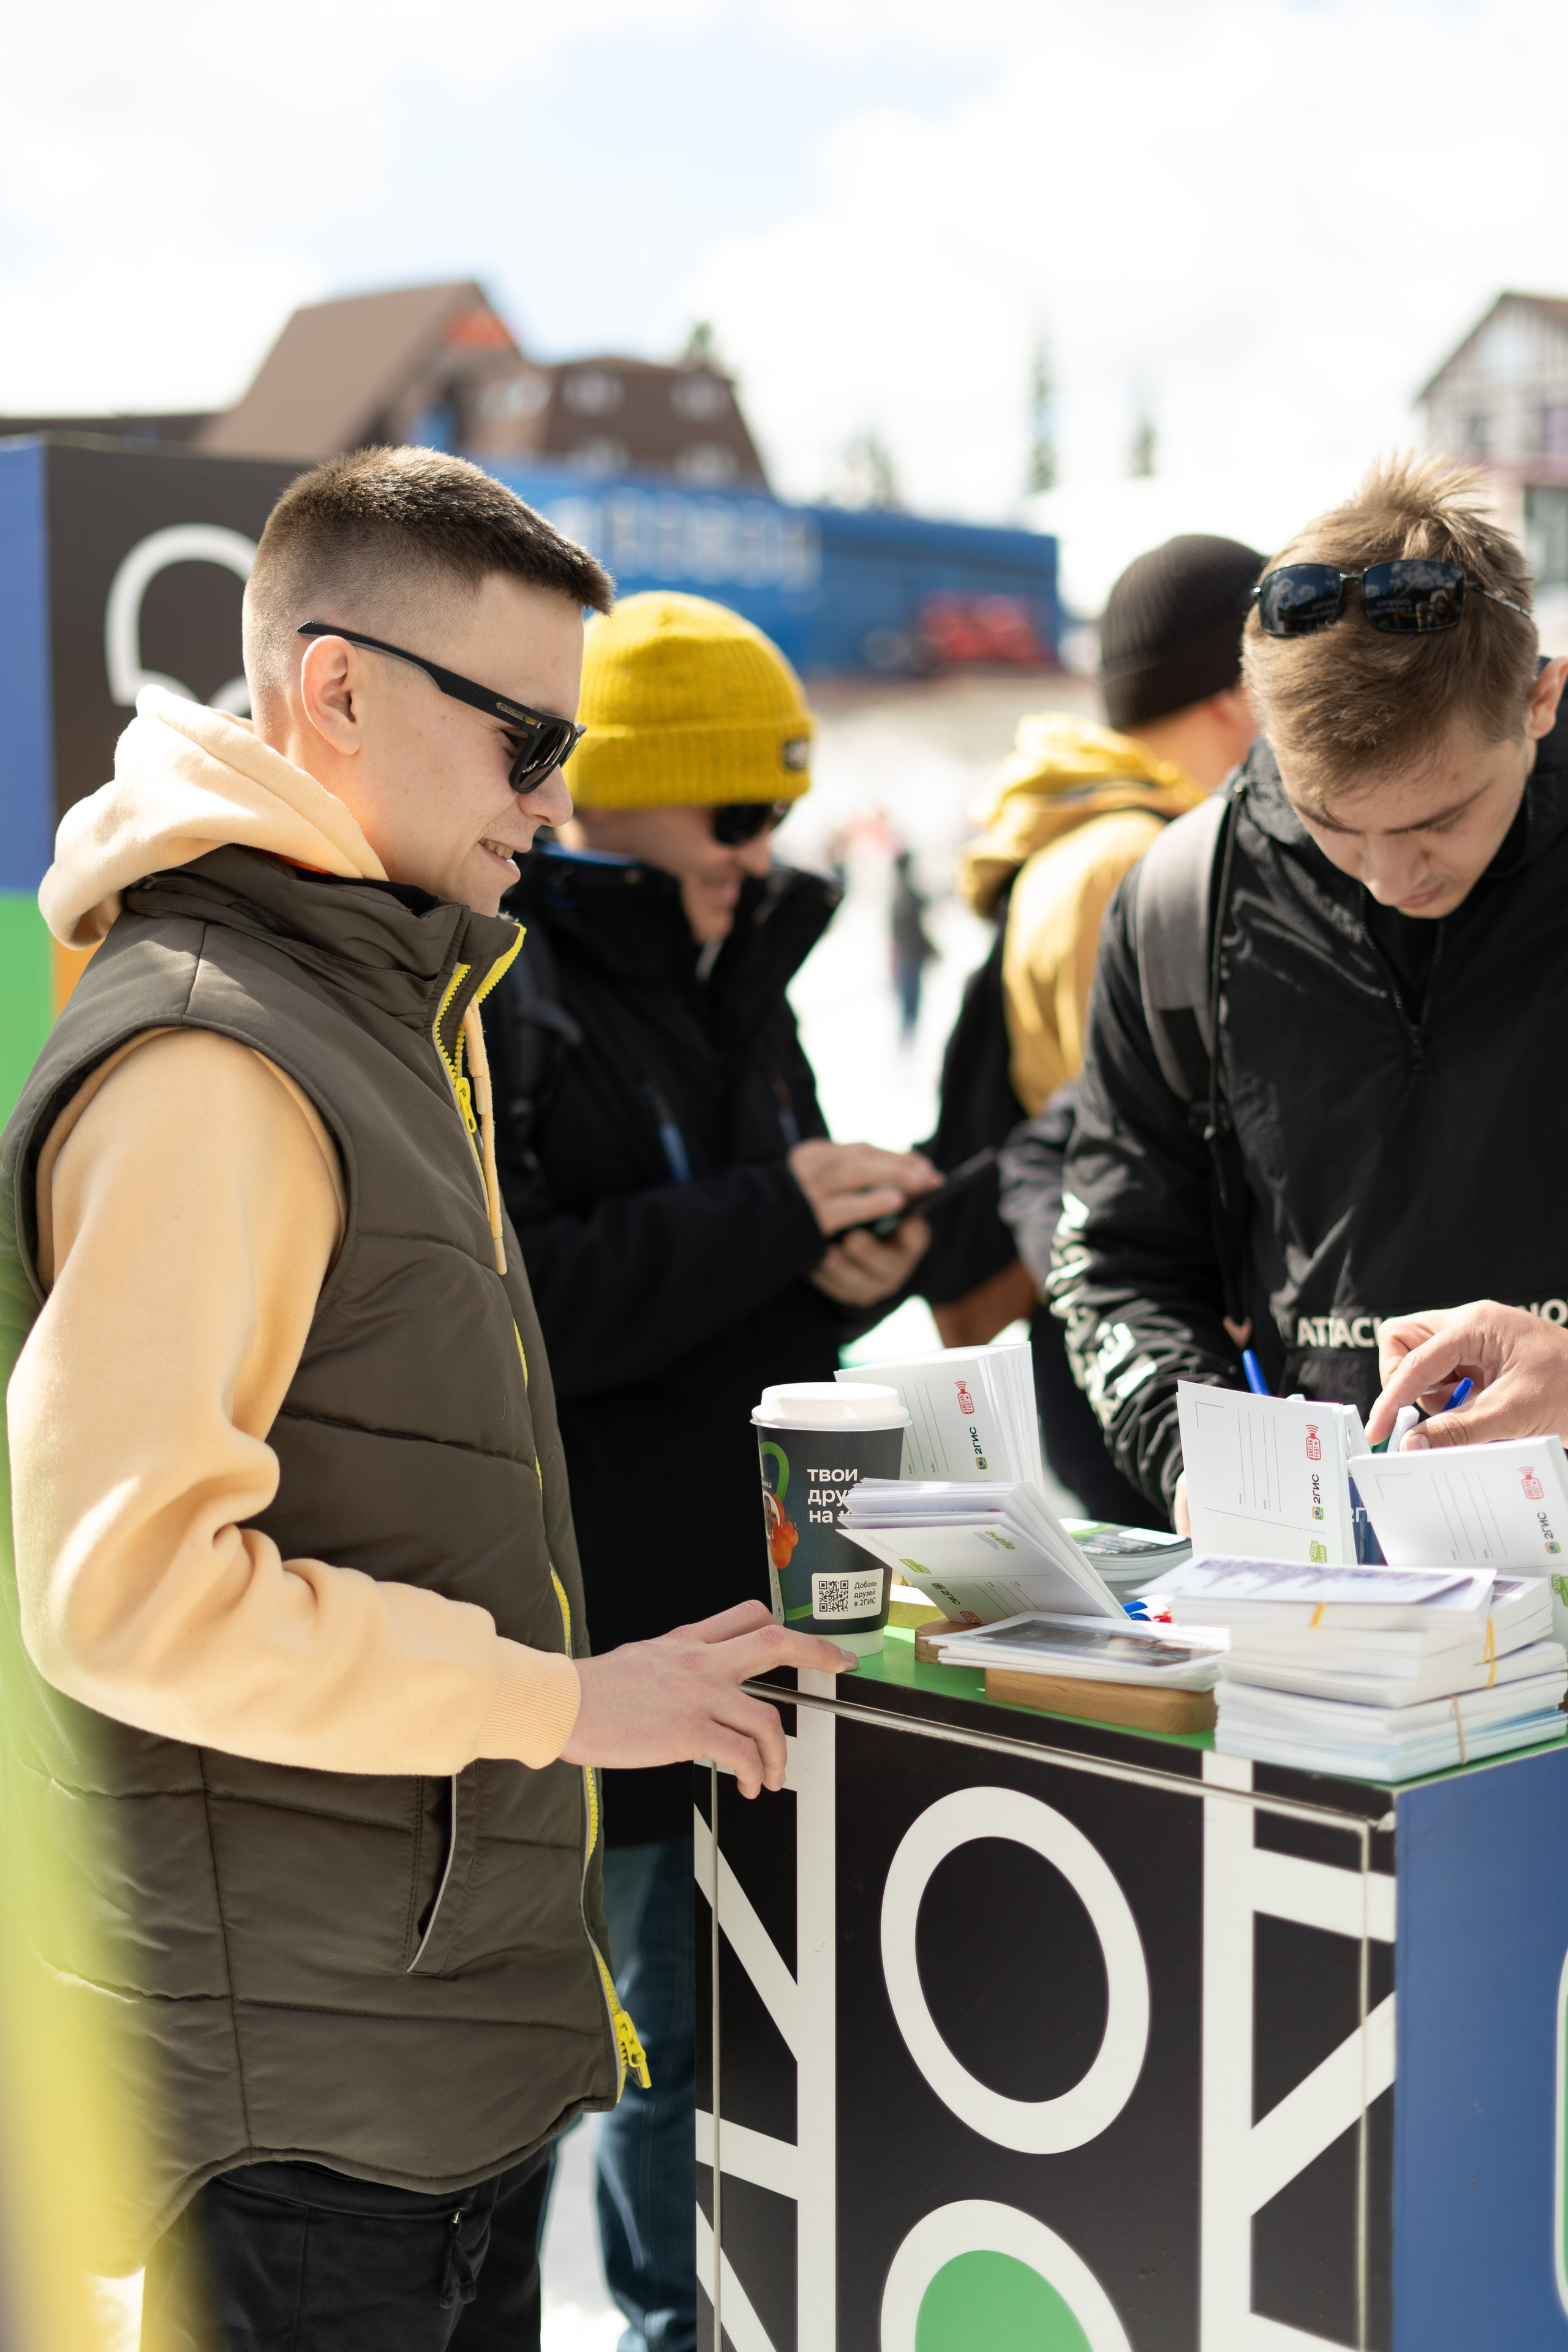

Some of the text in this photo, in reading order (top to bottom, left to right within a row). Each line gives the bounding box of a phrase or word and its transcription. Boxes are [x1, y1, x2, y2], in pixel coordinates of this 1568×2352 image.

[969, 1426, 982, 1455] 2ГИС
[1311, 1474, 1321, 1504] 2ГИС
[809, 1510, 833, 1523] на
[1537, 1512, 1554, 1539] 2ГИС
[854, 1580, 877, 1590] Добавь
[1552, 1574, 1561, 1594] -10%
[854, 1588, 876, 1599] друзей
[859, 1597, 876, 1606] 2ГИС
